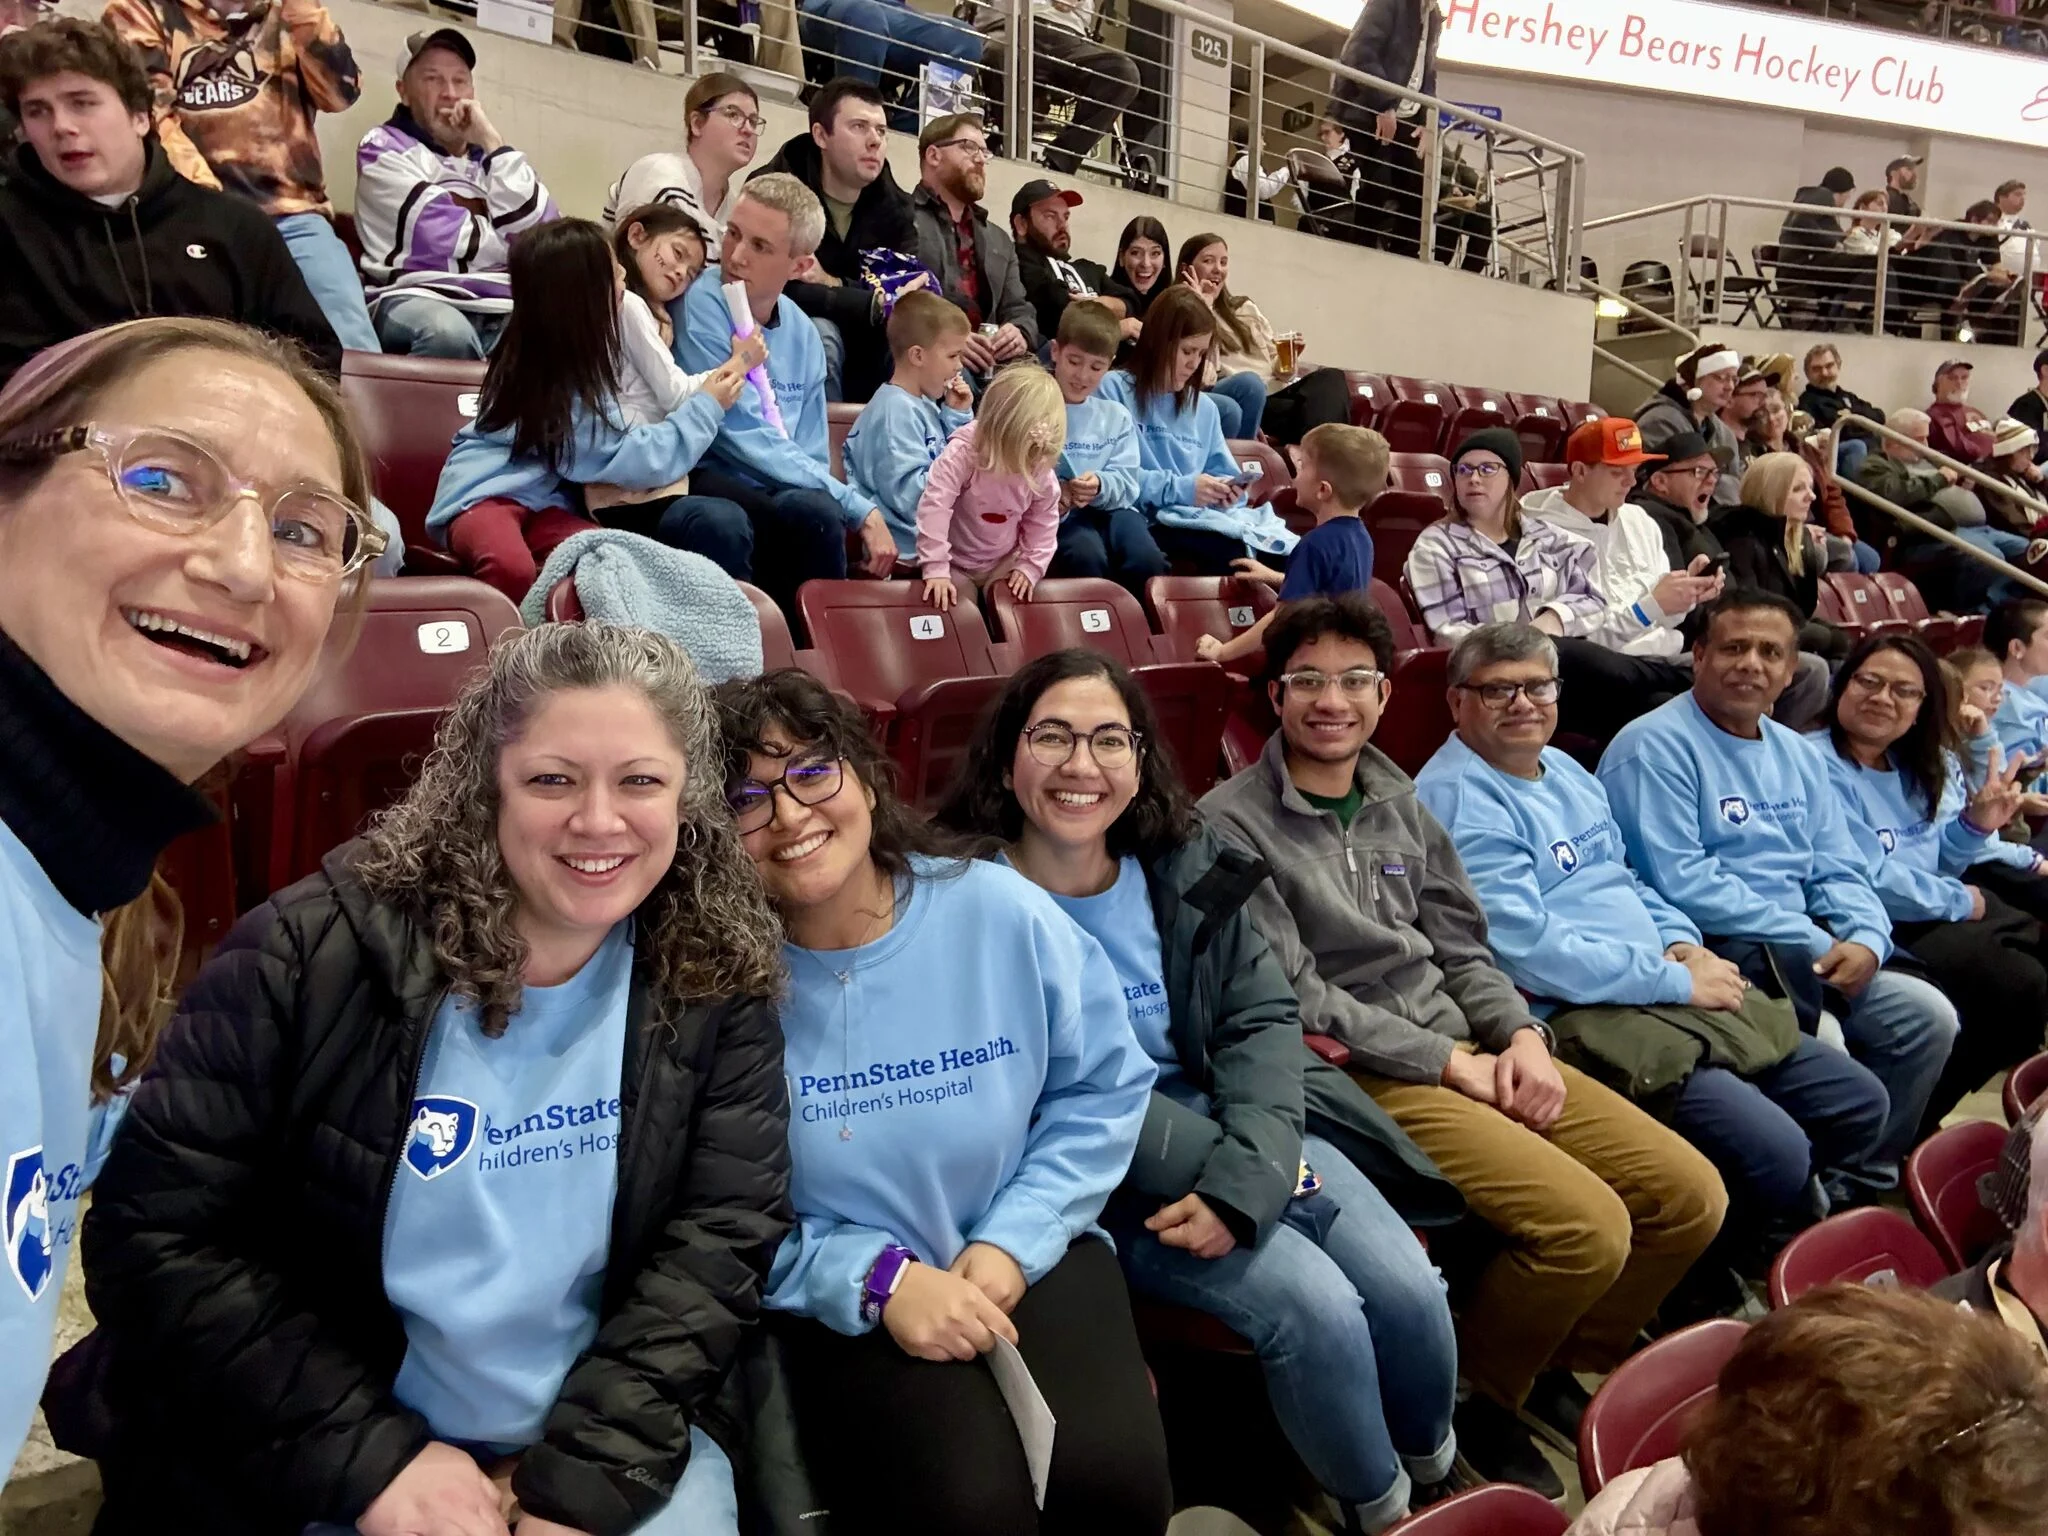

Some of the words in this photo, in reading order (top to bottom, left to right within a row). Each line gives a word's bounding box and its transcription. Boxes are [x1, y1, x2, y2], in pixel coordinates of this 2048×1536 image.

[1199, 36, 1221, 60] 125
[1446, 0, 1609, 66] Hershey
[1619, 14, 1723, 70] Bears
[1733, 32, 1862, 102] Hockey
[1871, 56, 1944, 104] Club
[922, 619, 933, 635] 4
[1090, 613, 1101, 628] 5
[1237, 610, 1247, 623] 6
[436, 627, 452, 647] 2
[800, 1058, 936, 1097] PennState
[802, 1092, 894, 1123] Children's
[898, 1075, 974, 1107] Hospital
